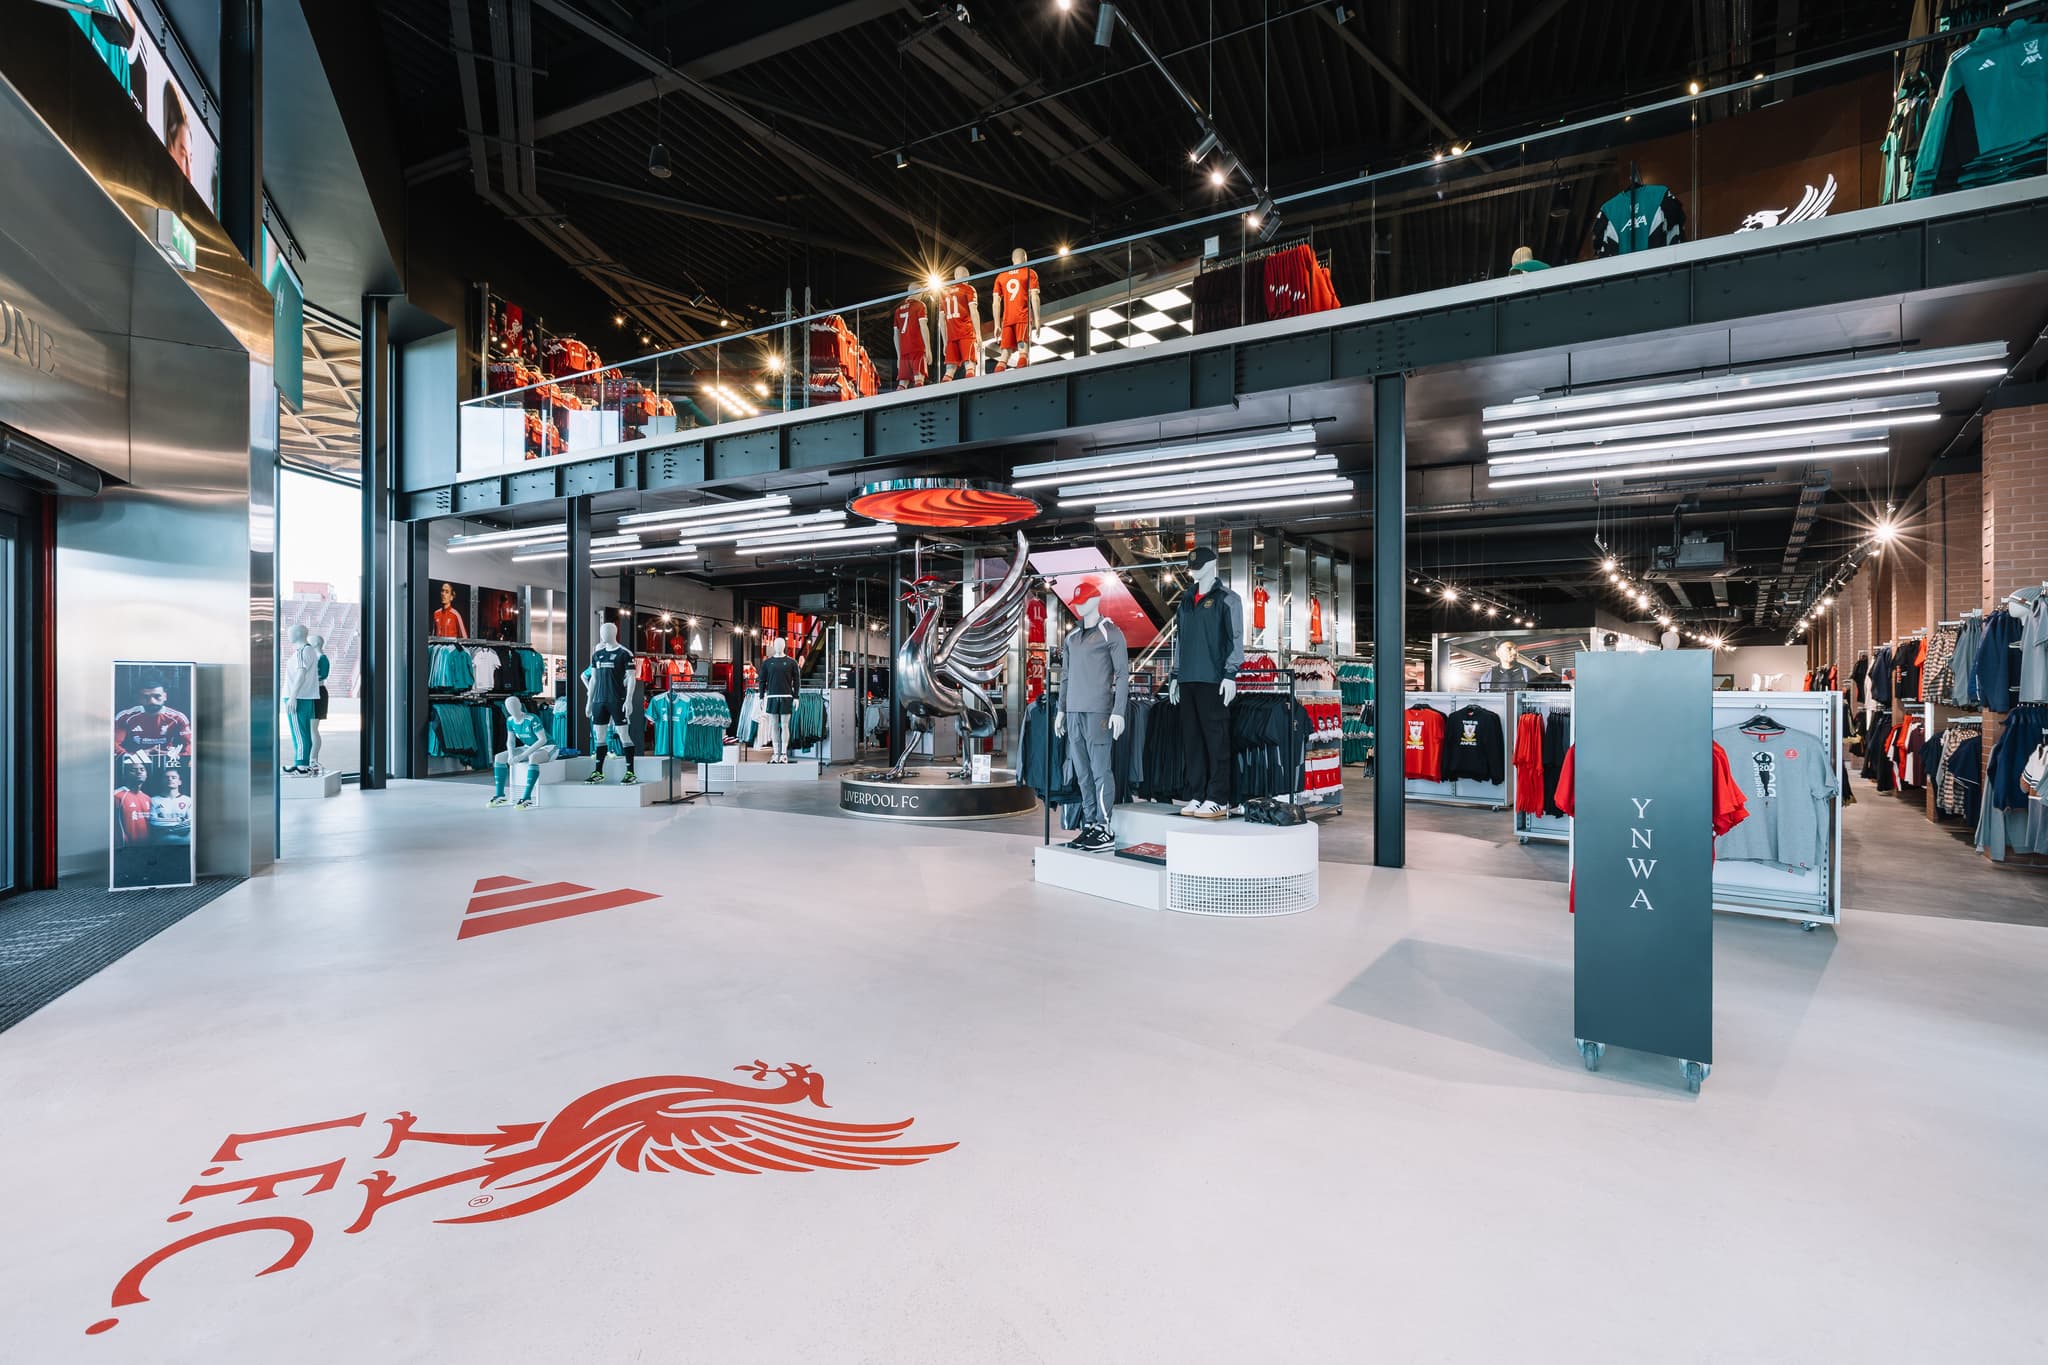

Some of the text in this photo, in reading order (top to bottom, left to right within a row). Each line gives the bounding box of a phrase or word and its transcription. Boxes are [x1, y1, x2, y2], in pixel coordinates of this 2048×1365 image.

[1006, 278, 1020, 302] 9
[945, 295, 960, 320] 11
[899, 312, 909, 334] 7
[844, 790, 919, 809] LIVERPOOL FC
[1626, 797, 1658, 911] YNWA
